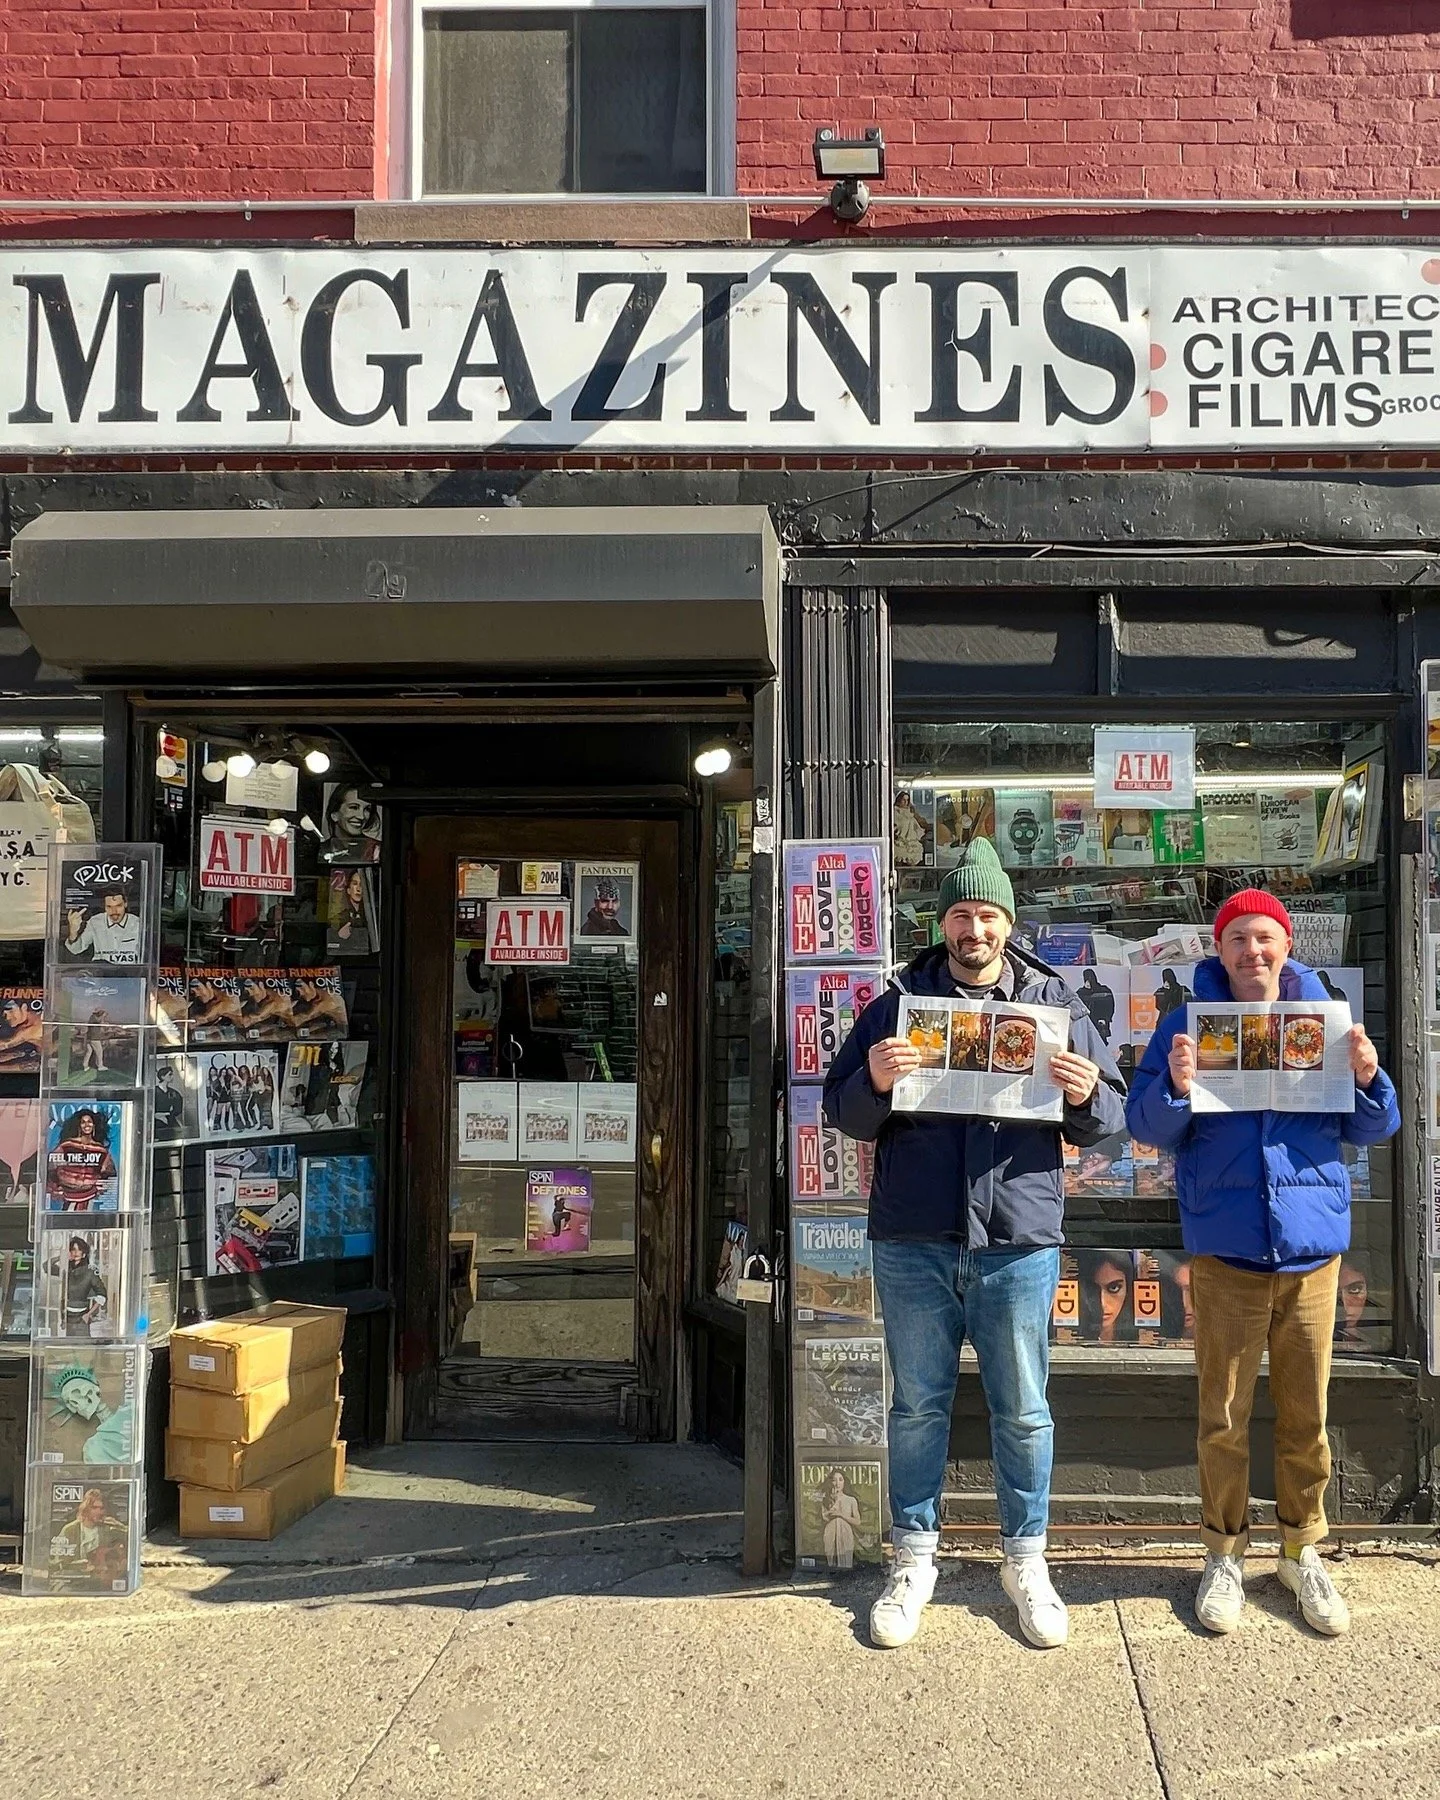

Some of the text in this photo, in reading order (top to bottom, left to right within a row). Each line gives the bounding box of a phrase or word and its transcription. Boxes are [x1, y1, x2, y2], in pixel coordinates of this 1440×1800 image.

[1173, 294, 1440, 323] ARCHITEC
[8, 267, 1137, 426] MAGAZINES
[1182, 329, 1435, 379] CIGARE
[1189, 382, 1383, 428] FILMS
[1381, 394, 1440, 415] GROC
[1118, 754, 1168, 780] ATM
[207, 830, 288, 876] ATM
[819, 856, 845, 869] Alta
[207, 874, 288, 890] AVAILABLE INSIDE
[540, 871, 559, 884] 2004
[581, 866, 634, 875] FANTASTIC
[794, 866, 873, 953] WE LOVE BOOK CLUBS
[494, 910, 564, 946] ATM
[494, 949, 563, 961] AVAILABLE INSIDE
[822, 975, 848, 989] Alta
[797, 991, 837, 1074] WE LOVE
[49, 1152, 102, 1163] FEEL THE JOY
[799, 1134, 819, 1194] WE
[843, 1139, 859, 1194] BOOK
[530, 1173, 552, 1183] SPIN
[532, 1185, 588, 1196] DEFTONES
[799, 1221, 868, 1251] Traveler
[1138, 1284, 1157, 1316] i-D
[812, 1352, 881, 1362] LEISURE
[55, 1487, 81, 1500] SPIN
